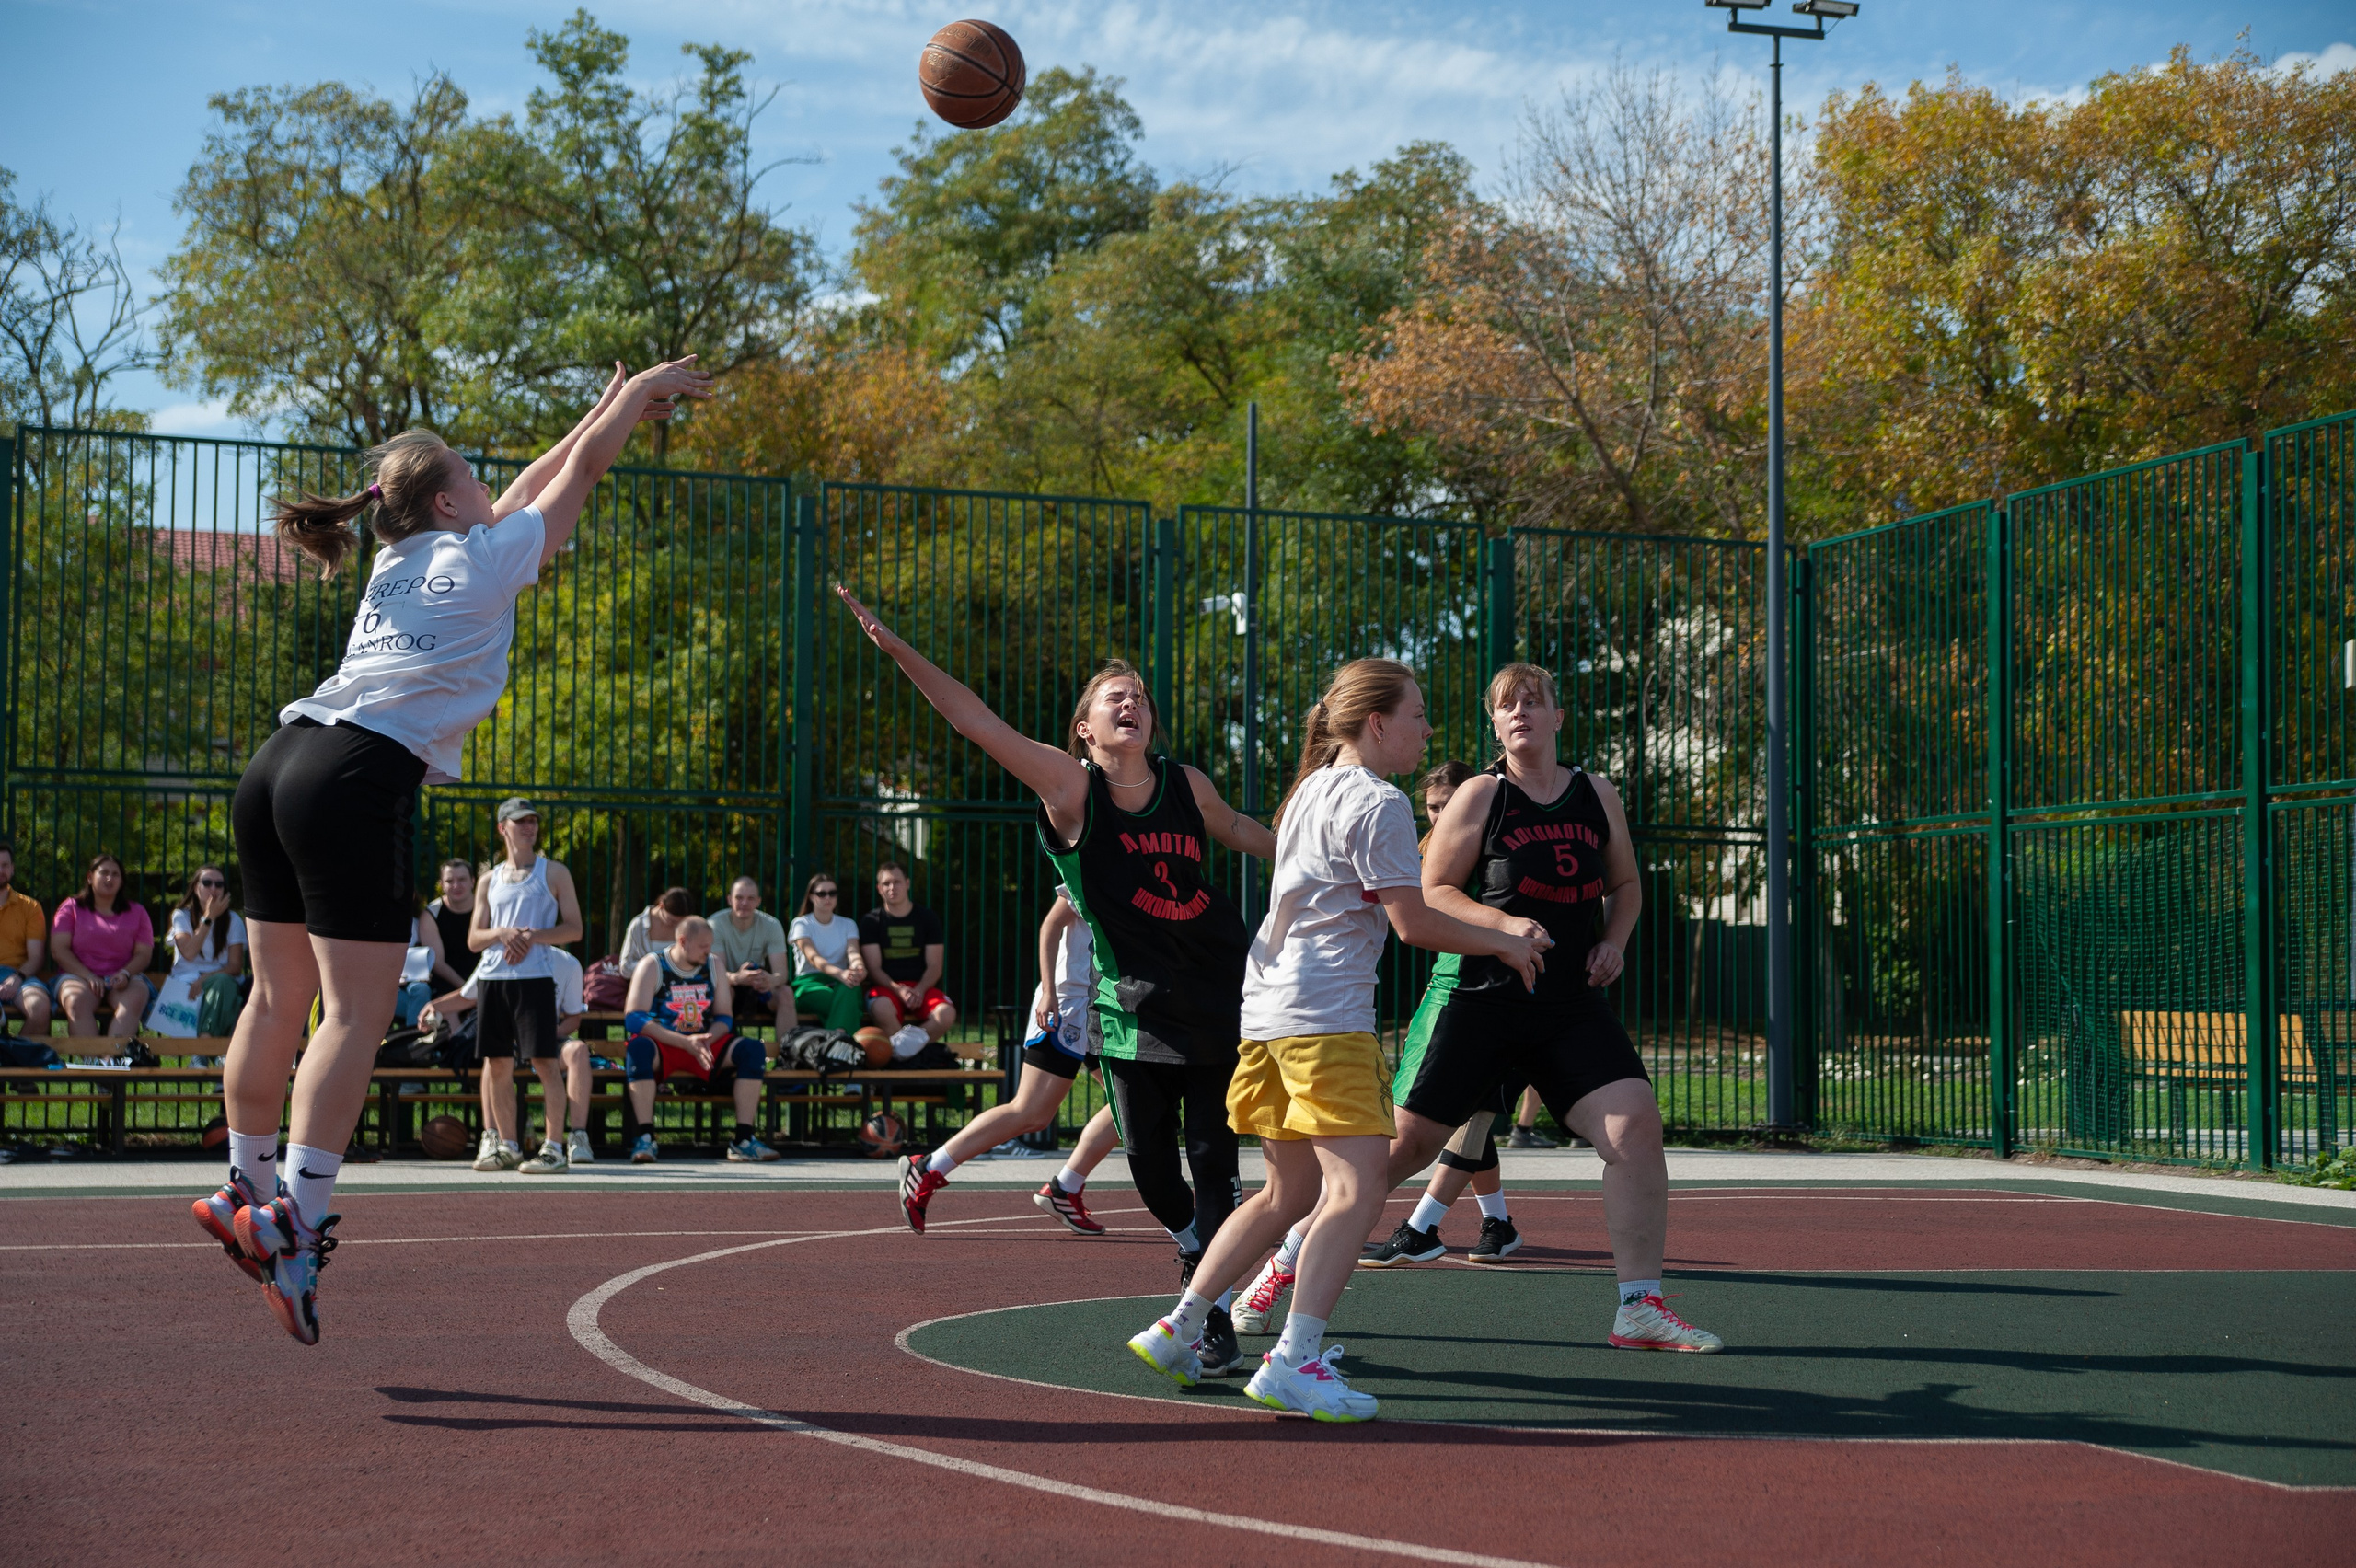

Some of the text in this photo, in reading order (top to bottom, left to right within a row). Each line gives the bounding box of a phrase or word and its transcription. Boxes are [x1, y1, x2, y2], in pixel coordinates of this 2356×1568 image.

[1502, 824, 1599, 851] ЛОКОМОТИВ
[1553, 843, 1579, 877] 5
[1154, 861, 1178, 899] 3
